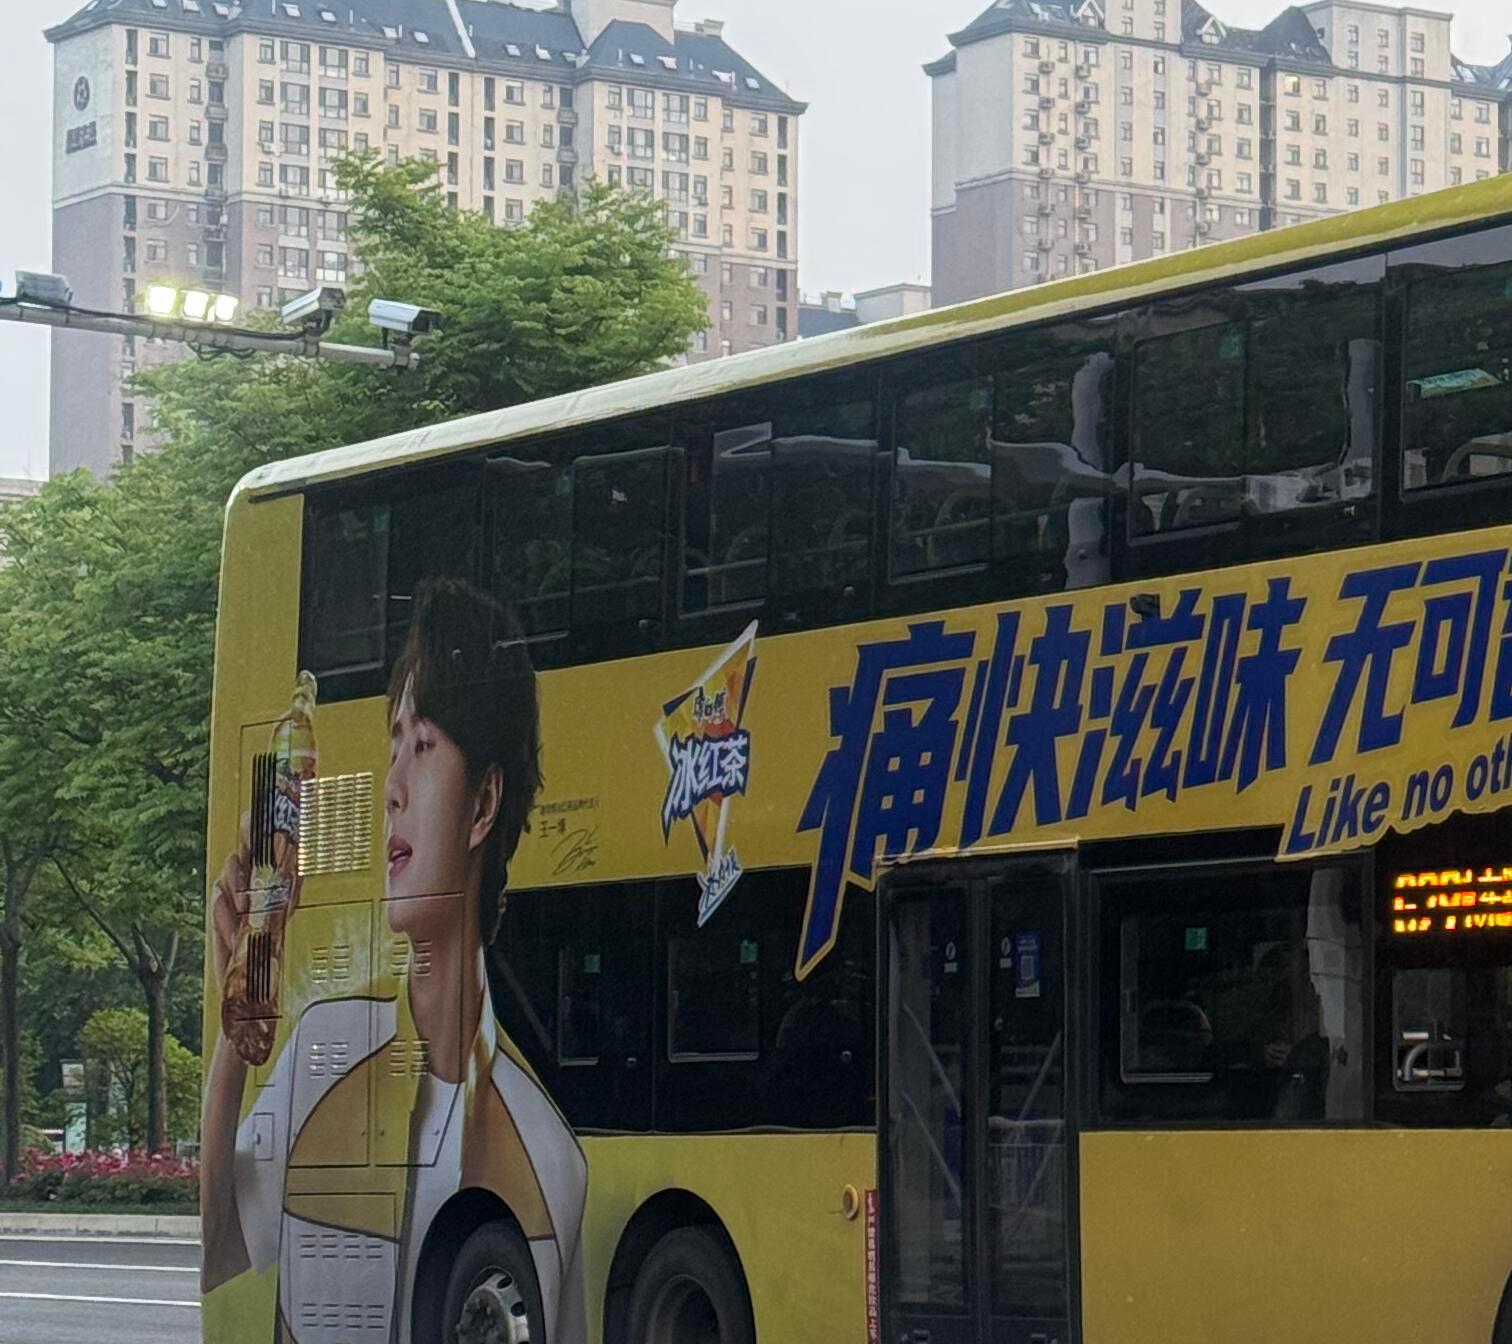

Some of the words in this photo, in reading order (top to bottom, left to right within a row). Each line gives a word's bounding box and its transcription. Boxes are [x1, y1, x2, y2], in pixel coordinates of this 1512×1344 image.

[664, 736, 747, 838] 冰红茶
[797, 577, 1306, 972] 痛快滋味
[1285, 785, 1386, 854] Like
[1401, 770, 1453, 810] no
